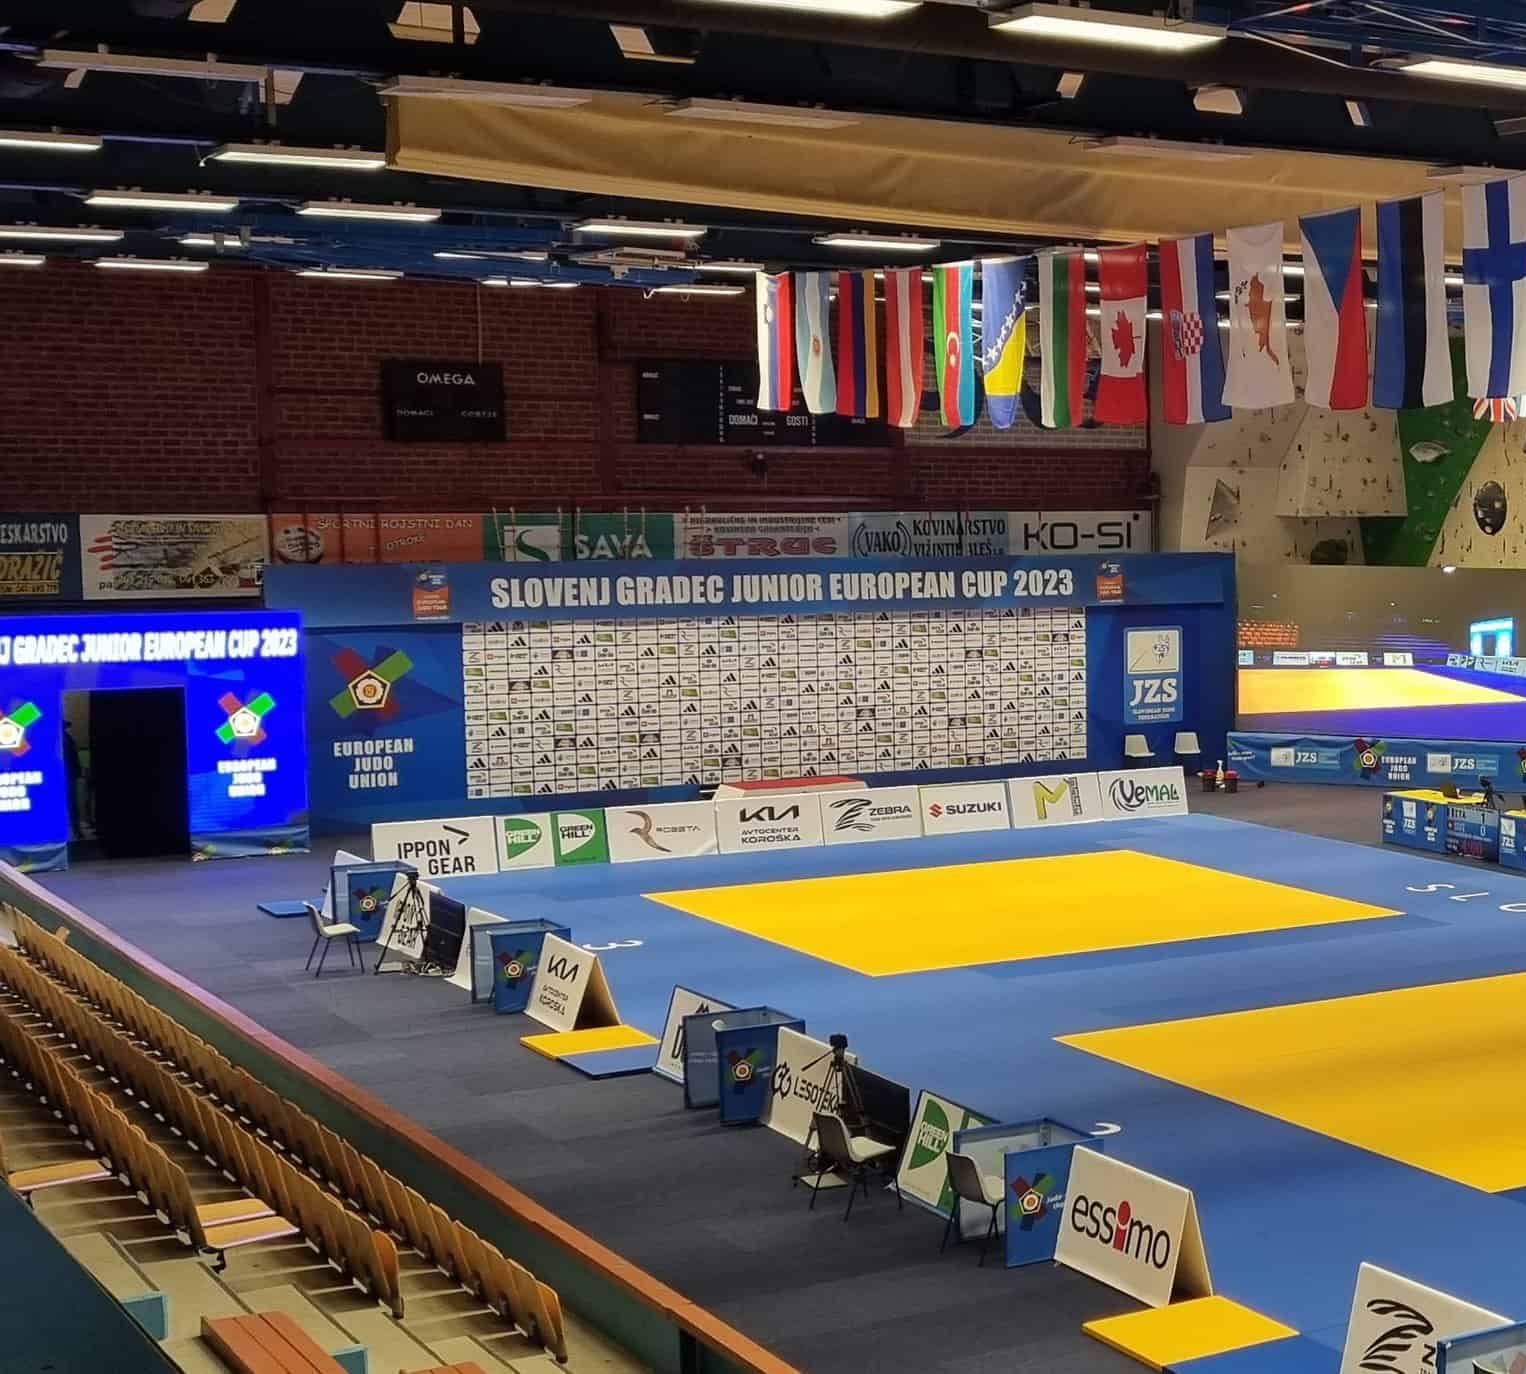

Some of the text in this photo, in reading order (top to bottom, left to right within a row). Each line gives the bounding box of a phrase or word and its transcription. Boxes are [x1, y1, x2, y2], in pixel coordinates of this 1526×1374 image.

[416, 372, 476, 386] OMEGA
[786, 415, 809, 425] GOSTI
[445, 519, 473, 528] DAN
[913, 519, 1006, 536] KOVINARSTVO
[865, 531, 900, 552] VAKO
[1023, 522, 1133, 550] KO-SI
[575, 534, 653, 560] SAVA
[491, 575, 611, 608] SLOVENJ
[617, 574, 724, 605] GRADEC
[731, 572, 822, 602] JUNIOR
[829, 570, 958, 600] EUROPEAN
[963, 569, 1007, 598] CUP
[1013, 569, 1074, 597] 2023
[13, 634, 80, 664] GRADEC
[81, 632, 143, 662] JUNIOR
[144, 630, 226, 661] EUROPEAN
[228, 629, 259, 658] CUP
[260, 628, 298, 657] 2023
[1130, 678, 1178, 706] JZS
[334, 738, 414, 757] EUROPEAN
[354, 756, 393, 772] JUDO
[1296, 752, 1317, 764] JZS
[1453, 758, 1475, 771] JZS
[349, 772, 399, 789] UNION
[740, 805, 800, 823] KIA
[869, 805, 912, 817] ZEBRA
[946, 801, 1002, 815] SUZUKI
[560, 824, 593, 833] GREEN
[561, 830, 592, 839] HILL
[741, 826, 799, 836] AVTOCENTER
[741, 833, 801, 844] KOROŠKA
[397, 839, 451, 859] IPPON
[428, 855, 476, 875] GEAR
[547, 953, 580, 984] KIA
[1071, 1195, 1171, 1270] essimo
